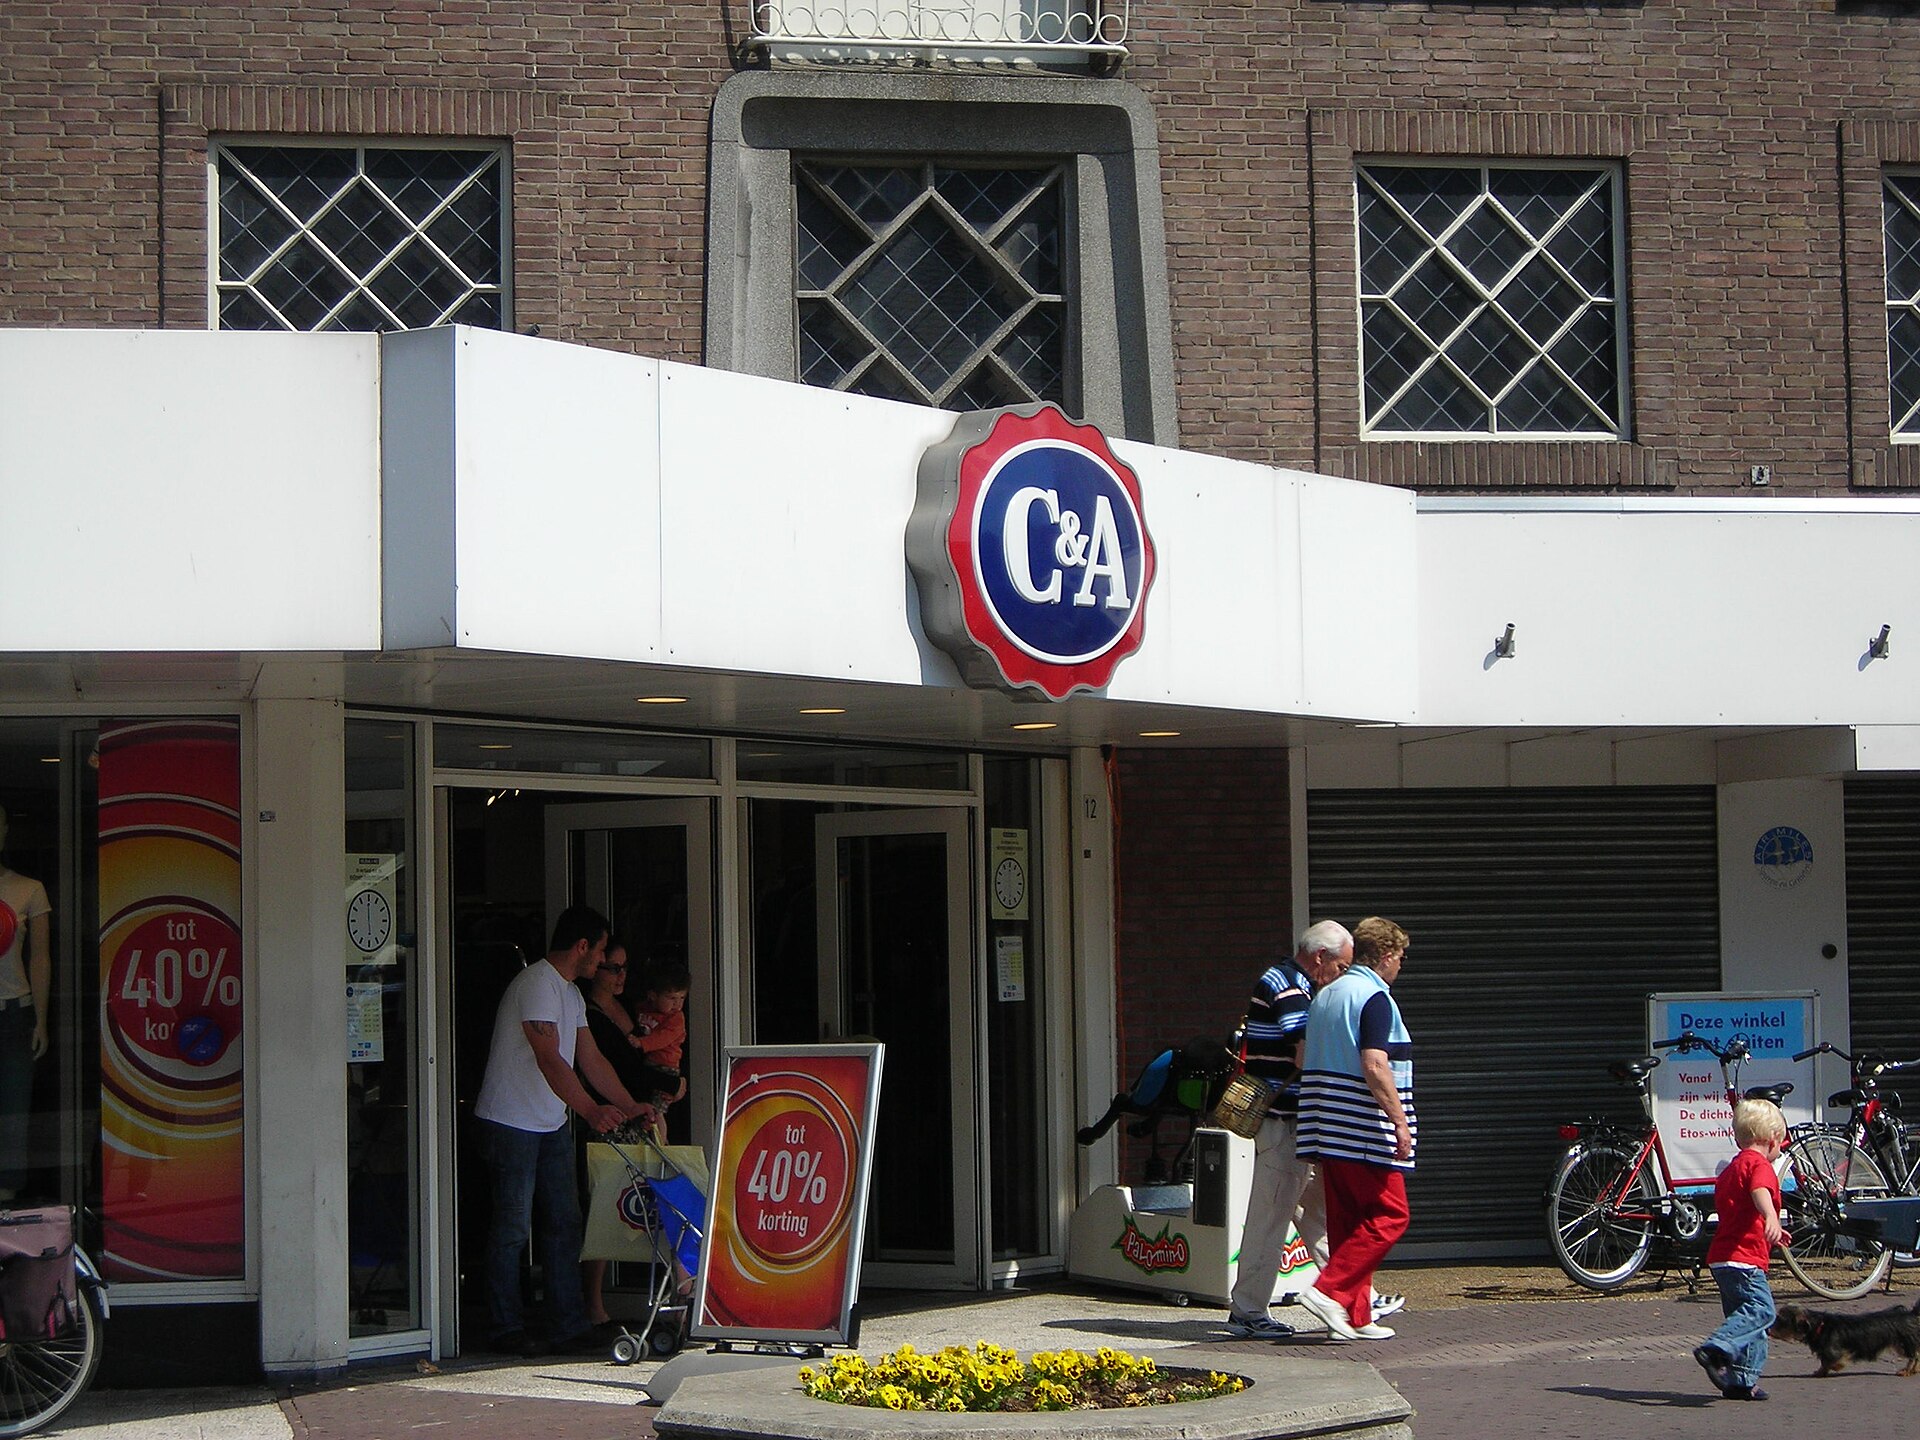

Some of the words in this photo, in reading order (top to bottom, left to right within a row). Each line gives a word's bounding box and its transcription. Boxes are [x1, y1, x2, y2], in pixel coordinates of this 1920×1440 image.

[1003, 486, 1131, 609] C&A
[1085, 798, 1097, 818] 12
[1756, 835, 1770, 861] AIR
[166, 919, 197, 941] tot
[122, 948, 241, 1008] 40%
[1680, 1013, 1724, 1029] Deze
[1731, 1011, 1786, 1028] winkel
[1679, 1073, 1712, 1084] Vanaf
[1679, 1091, 1699, 1104] zijn
[1704, 1090, 1719, 1103] wij
[1680, 1110, 1696, 1120] De
[1700, 1109, 1734, 1120] dichts
[786, 1124, 806, 1145] tot
[1680, 1127, 1735, 1138] Etos-wink
[747, 1150, 827, 1204] 40%
[758, 1209, 809, 1238] korting
